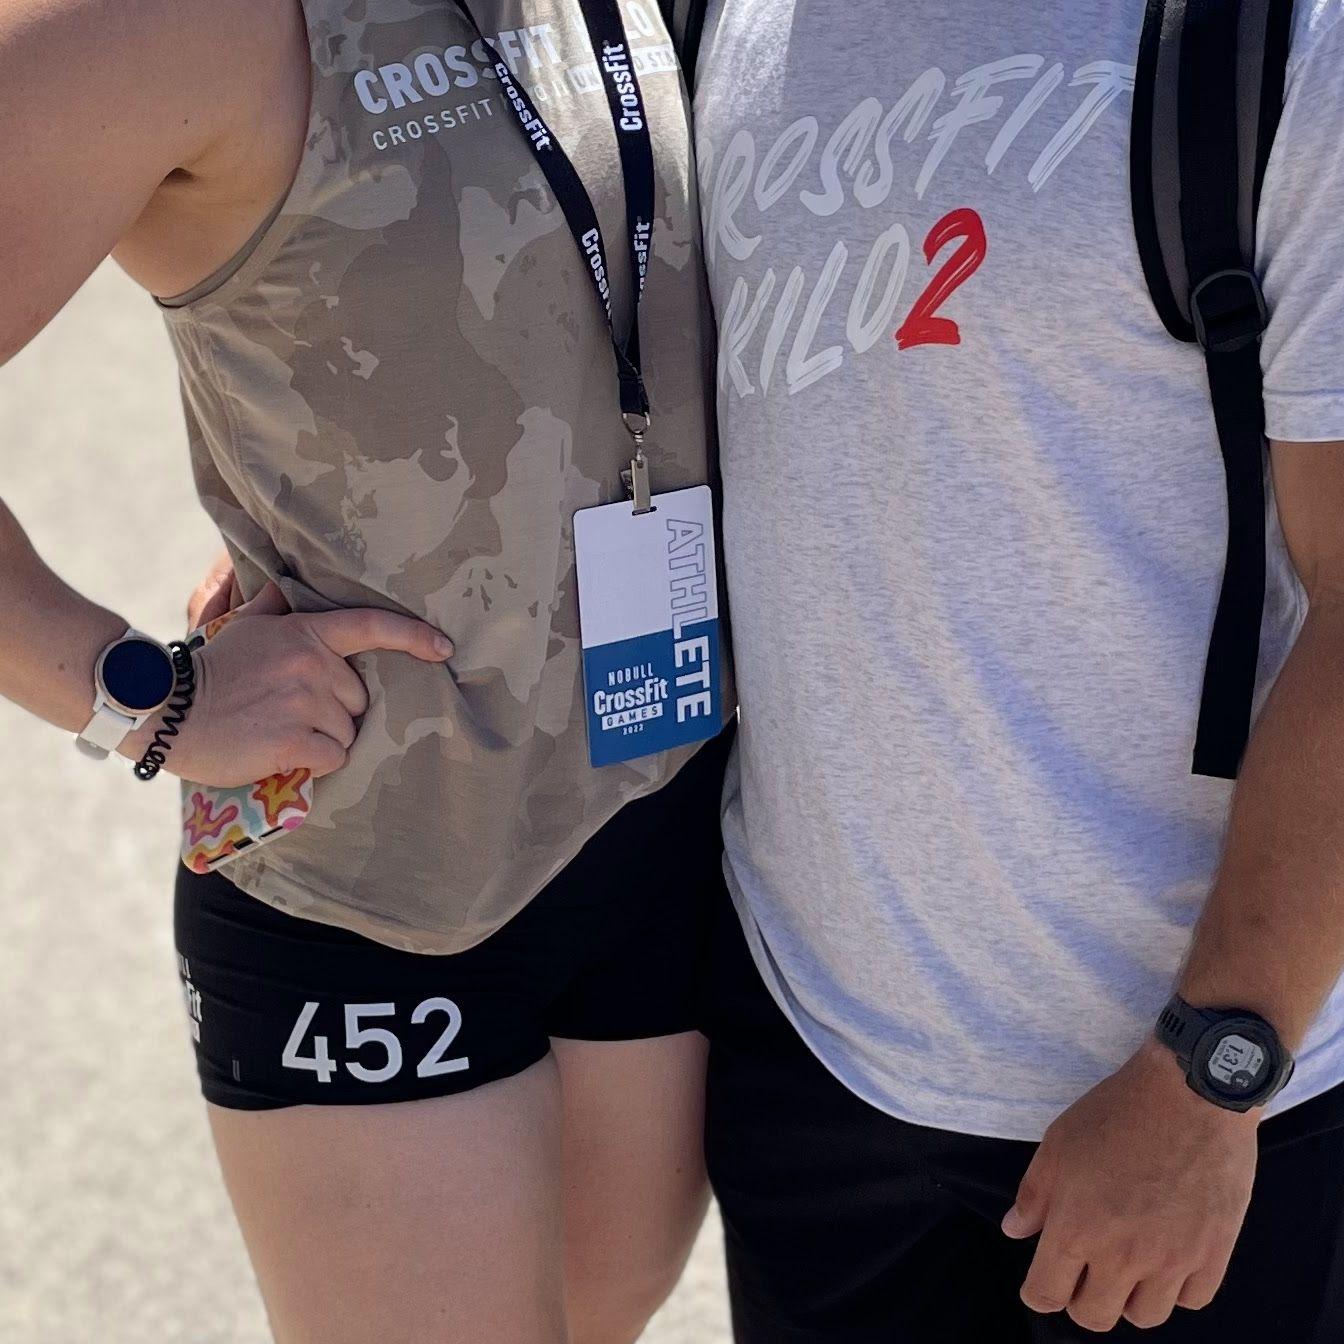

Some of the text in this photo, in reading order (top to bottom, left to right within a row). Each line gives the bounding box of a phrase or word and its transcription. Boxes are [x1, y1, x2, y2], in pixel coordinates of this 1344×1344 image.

[495, 62, 550, 151] CrossFit
[603, 42, 643, 131] CrossFit
[373, 98, 493, 151] CROSSFIT
[697, 54, 1136, 260] ROSSFIT
[666, 519, 712, 723] ATHLETE
[594, 677, 668, 715] CrossFit
[608, 662, 654, 686] NOBULL
[607, 705, 658, 727] GAMES
[282, 997, 469, 1083] 452
[1218, 1044, 1244, 1073] 1:31
